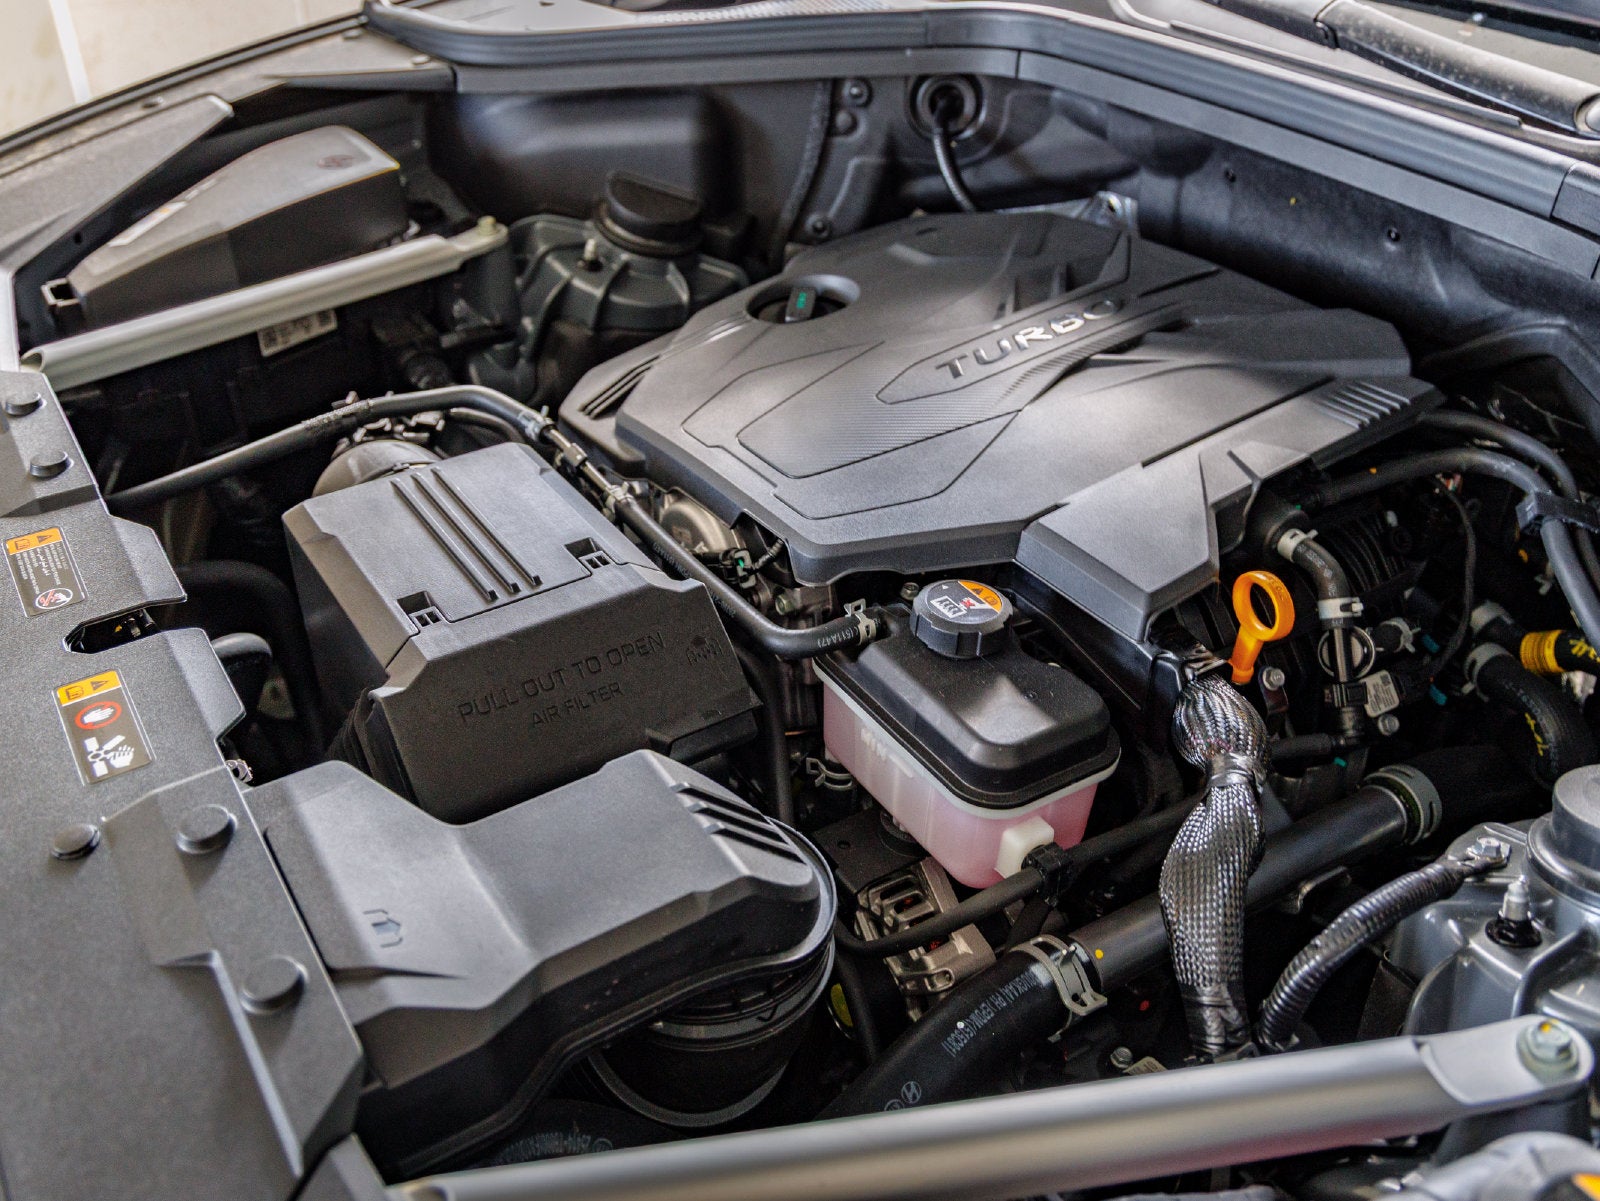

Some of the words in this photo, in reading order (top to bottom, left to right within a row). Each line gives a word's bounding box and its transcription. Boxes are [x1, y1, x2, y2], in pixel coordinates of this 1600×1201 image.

[935, 300, 1120, 379] TURBO
[457, 688, 519, 723] PULL
[521, 668, 567, 697] OUT
[571, 655, 602, 680] TO
[607, 632, 666, 667] OPEN
[531, 706, 562, 727] AIR
[564, 682, 623, 715] FILTER
